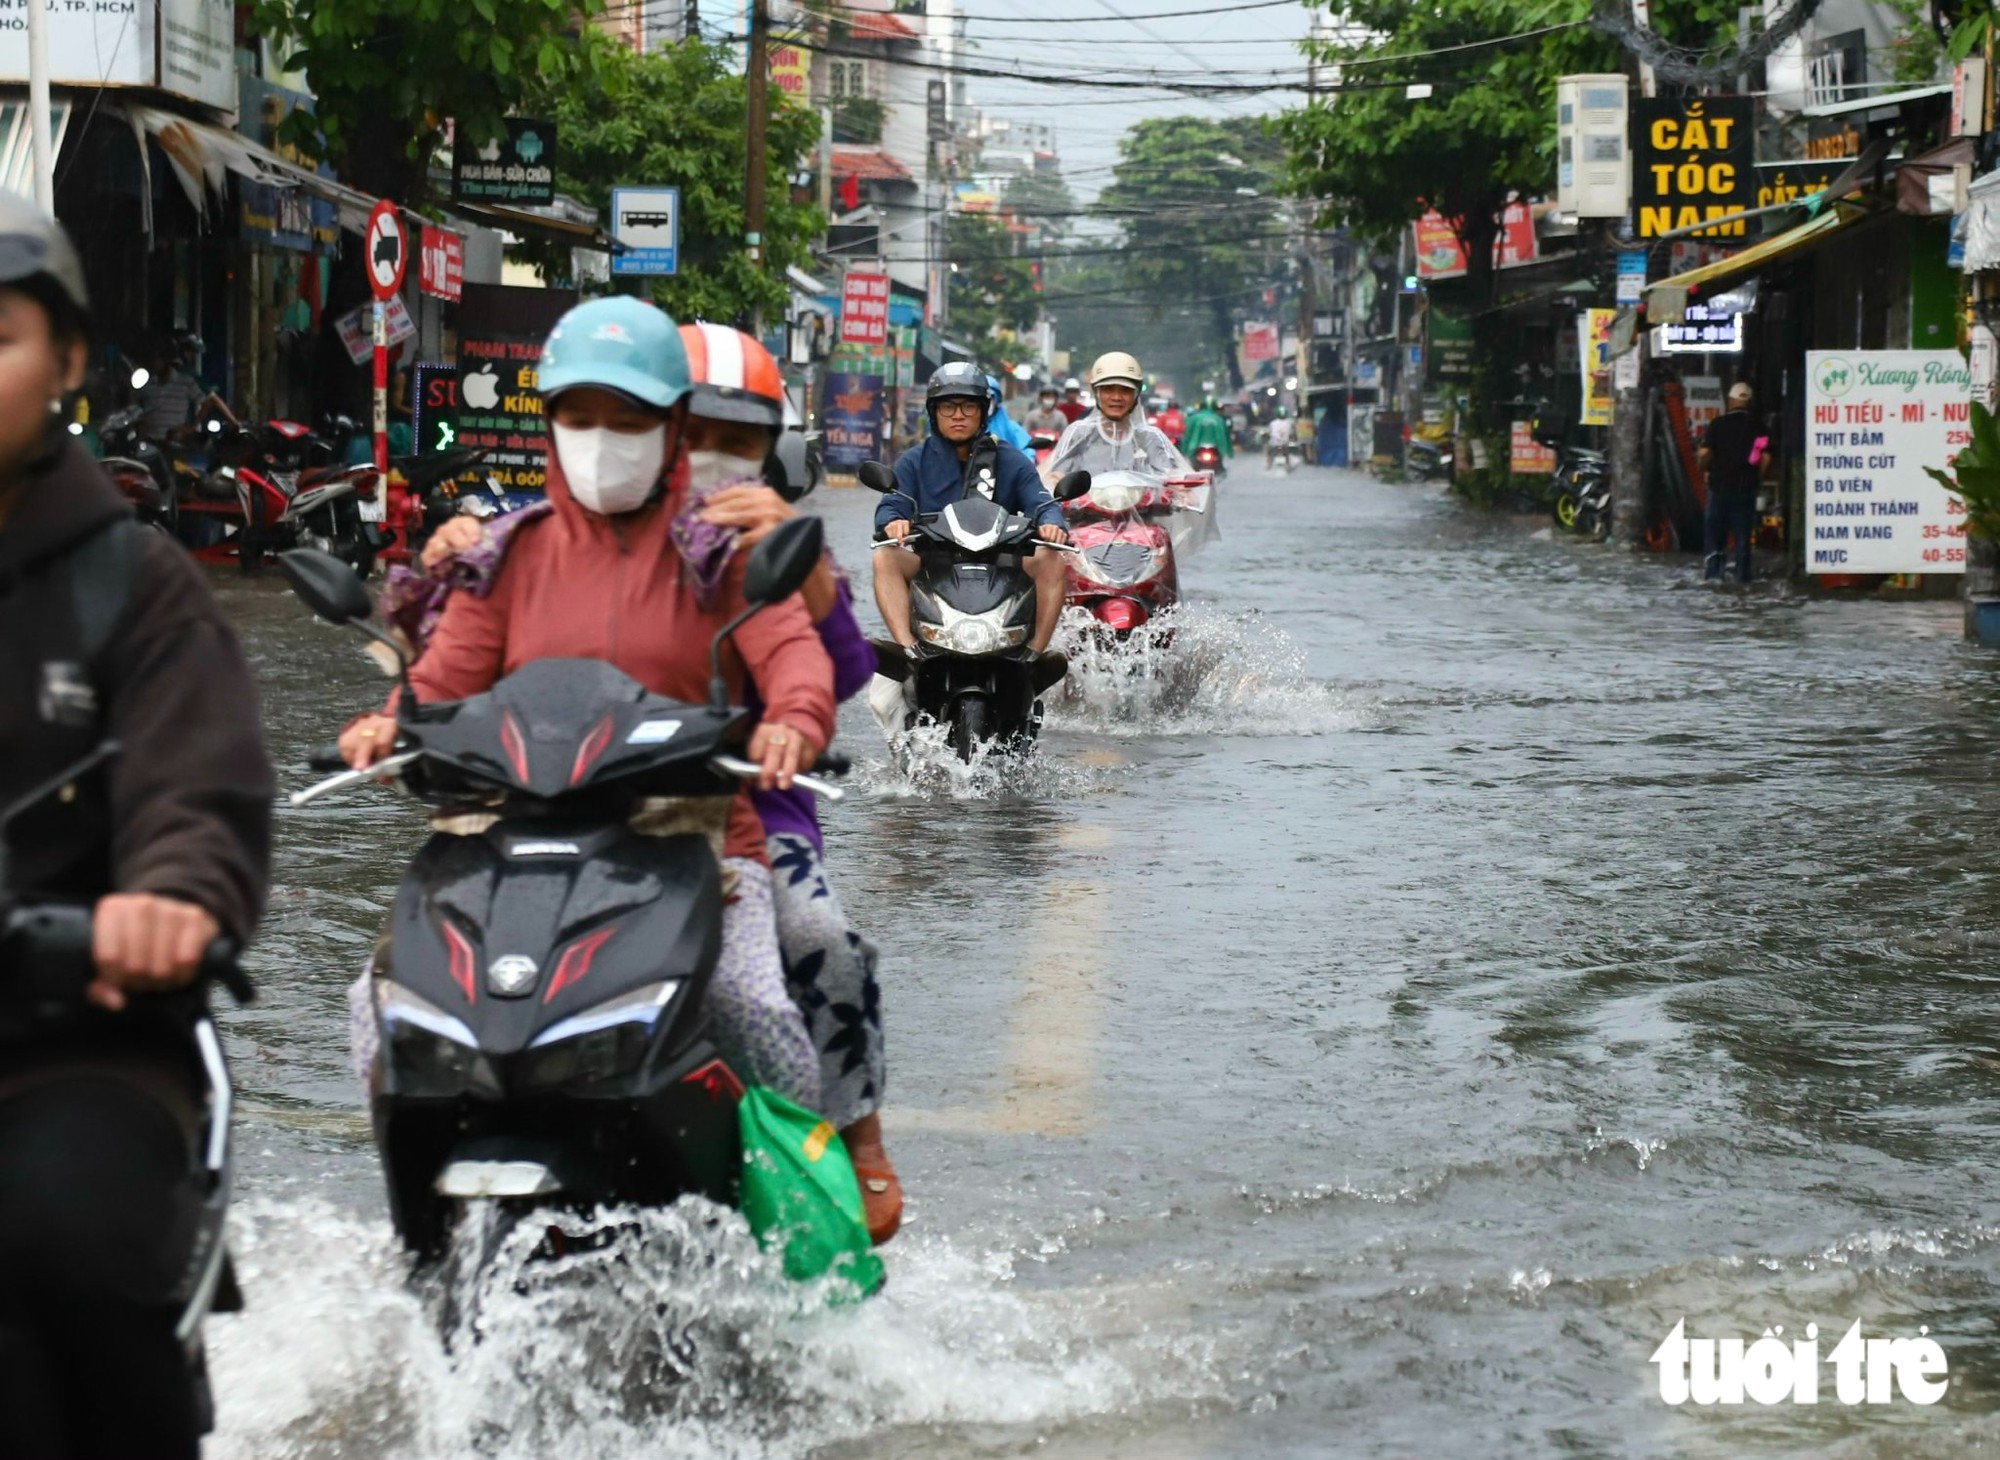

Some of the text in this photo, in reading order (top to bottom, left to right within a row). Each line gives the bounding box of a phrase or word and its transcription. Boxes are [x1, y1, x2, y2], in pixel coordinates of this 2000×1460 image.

[96, 2, 135, 13] HCM
[1652, 102, 1734, 150] CẮT
[1651, 154, 1735, 195] TÓC
[1640, 206, 1745, 237] NAM
[643, 262, 668, 272] STOP
[1858, 362, 1919, 393] Xương
[1845, 398, 1883, 423] TIẾU
[1815, 432, 1845, 449] THỊT
[1840, 477, 1873, 493] VIÊN
[1946, 502, 1968, 515] 35
[1815, 526, 1849, 540] NAM
[1855, 526, 1893, 540] VANG
[1815, 549, 1967, 567] MỰC 40-55
